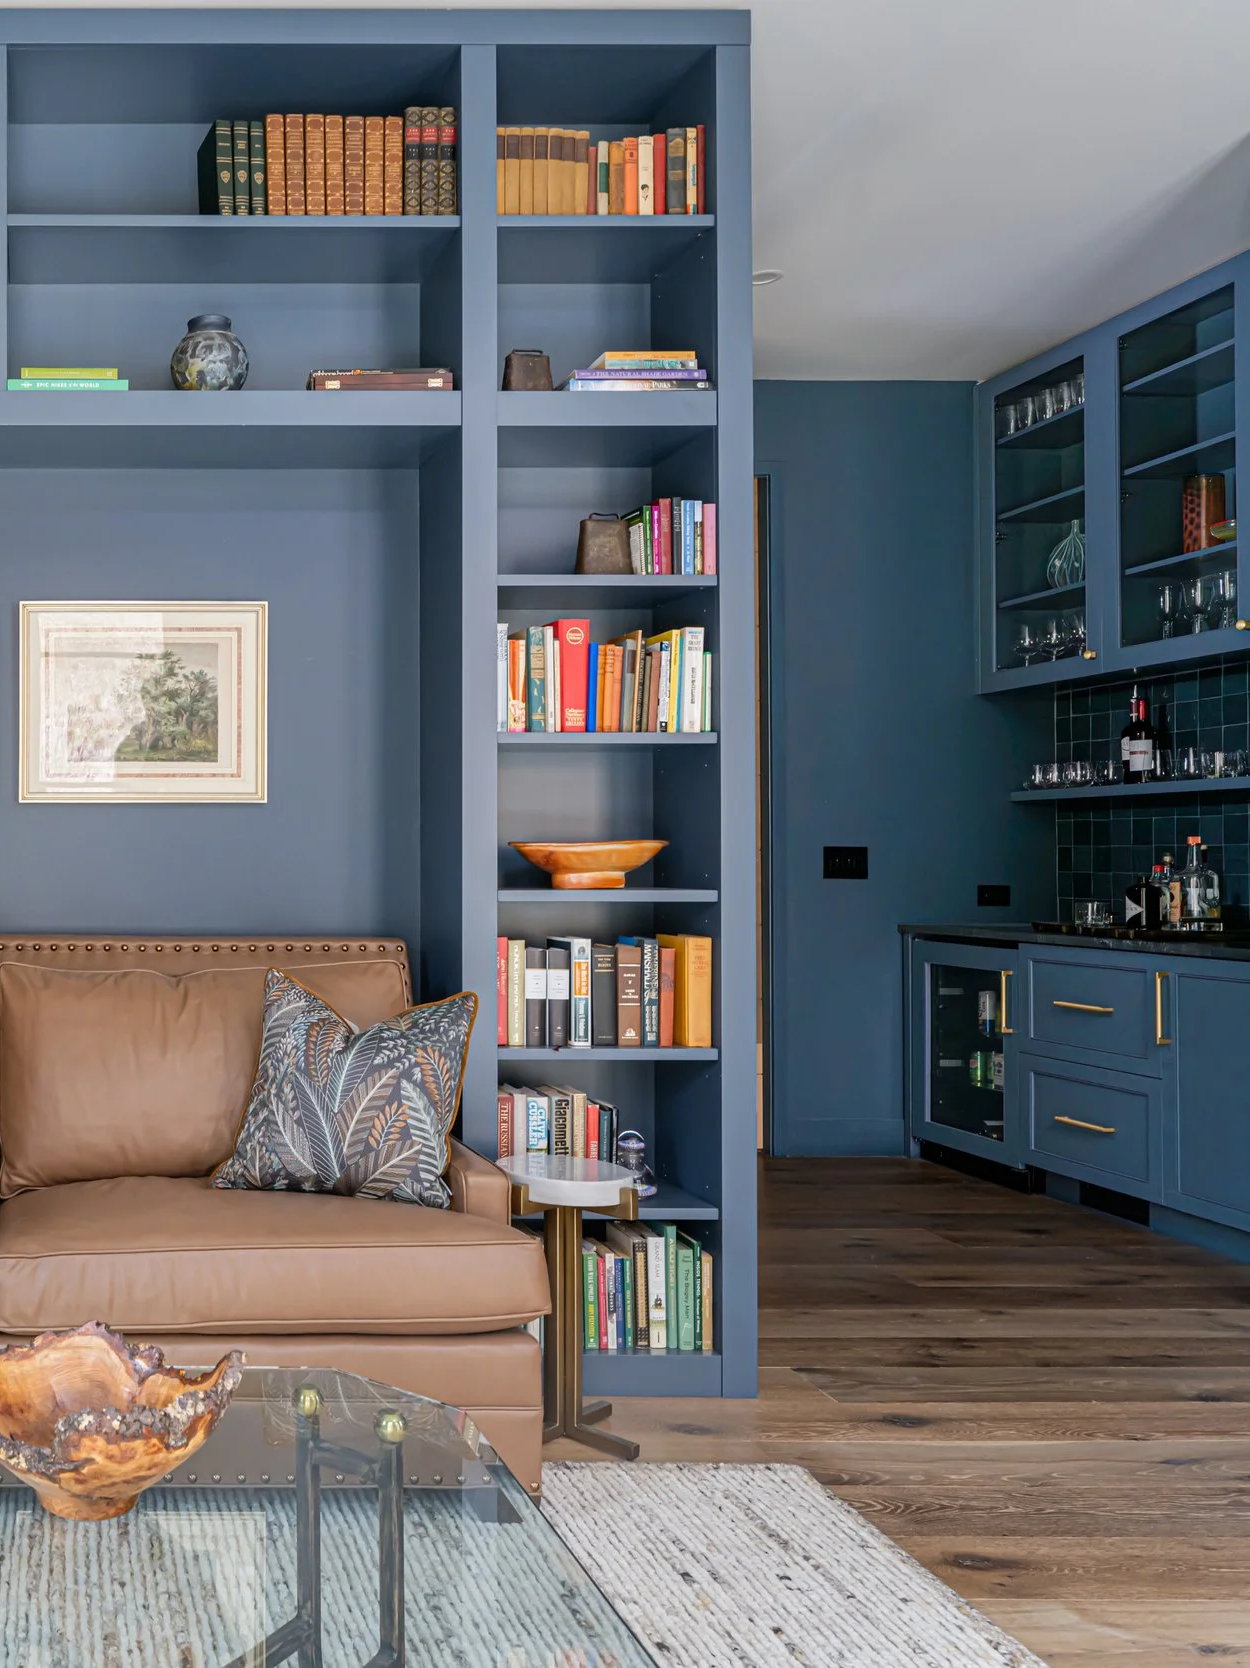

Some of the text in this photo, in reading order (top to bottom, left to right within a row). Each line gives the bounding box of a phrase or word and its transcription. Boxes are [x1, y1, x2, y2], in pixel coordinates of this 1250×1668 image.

[644, 944, 652, 989] MARSHALL
[501, 1103, 509, 1122] THE
[529, 1102, 538, 1145] CUSSLER
[537, 1108, 546, 1138] CLIVE
[554, 1098, 570, 1156] Giacomett
[590, 1141, 598, 1160] FAHRE
